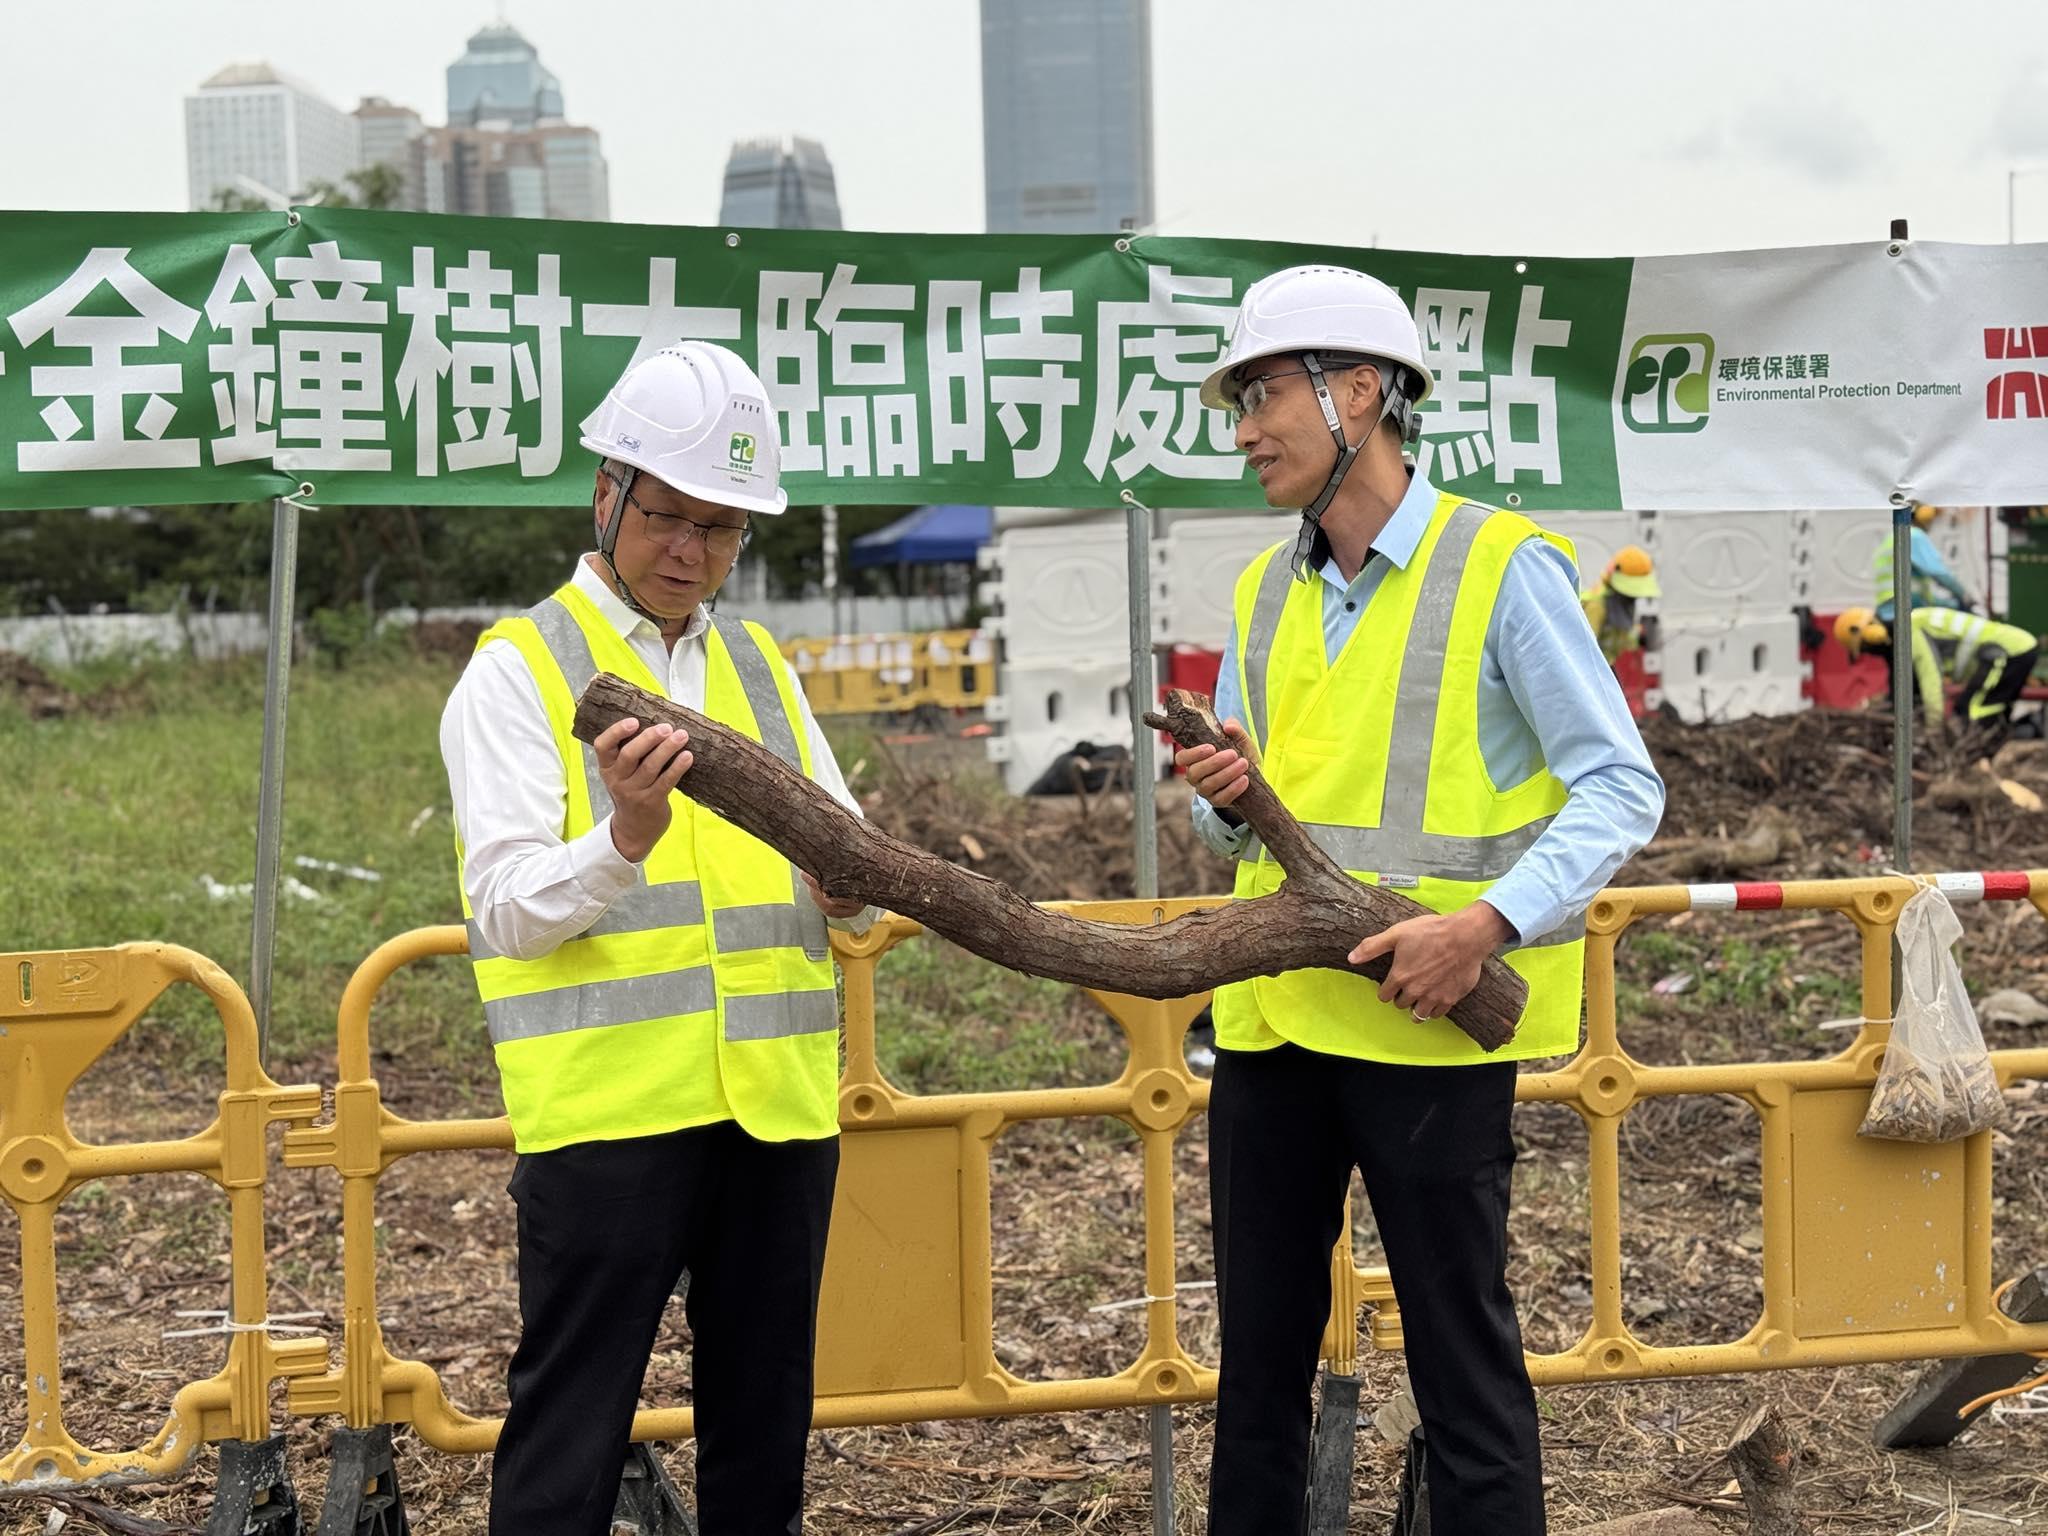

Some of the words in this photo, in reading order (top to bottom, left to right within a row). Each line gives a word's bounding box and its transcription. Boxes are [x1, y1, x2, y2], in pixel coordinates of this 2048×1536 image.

[1718, 354, 1830, 382] 環境保護署
[1716, 385, 1815, 402] Environmental
[1818, 383, 1891, 399] Protection
[1896, 381, 1962, 397] Department
